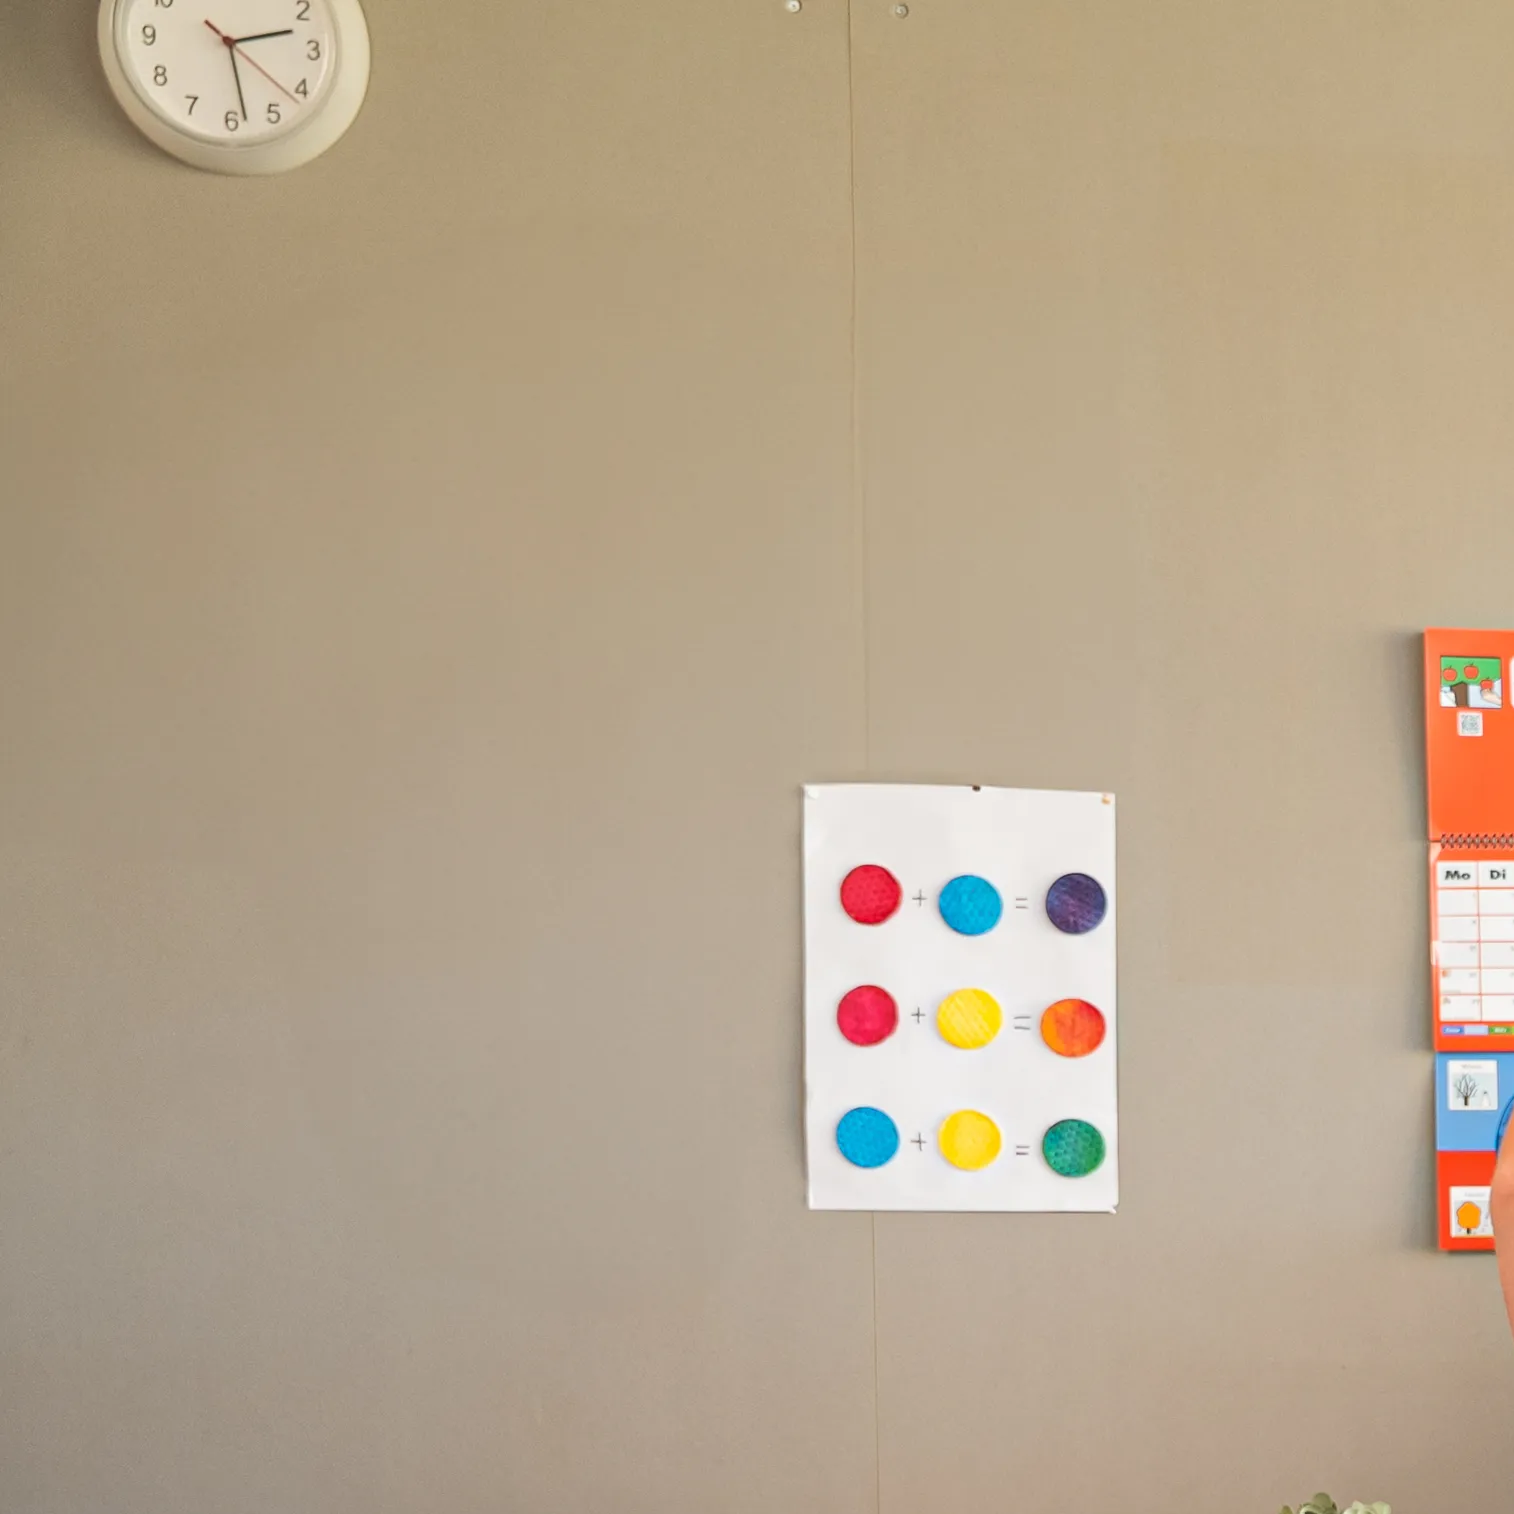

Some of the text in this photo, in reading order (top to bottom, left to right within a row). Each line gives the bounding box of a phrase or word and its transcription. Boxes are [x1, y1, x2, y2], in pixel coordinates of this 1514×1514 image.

[296, 0, 310, 21] 2
[142, 24, 156, 46] 9
[306, 40, 321, 61] 3
[153, 65, 168, 86] 8
[294, 79, 309, 98] 4
[184, 95, 199, 116] 7
[266, 103, 281, 124] 5
[224, 110, 239, 131] 6
[1444, 870, 1471, 880] Mo
[1489, 869, 1506, 880] Di
